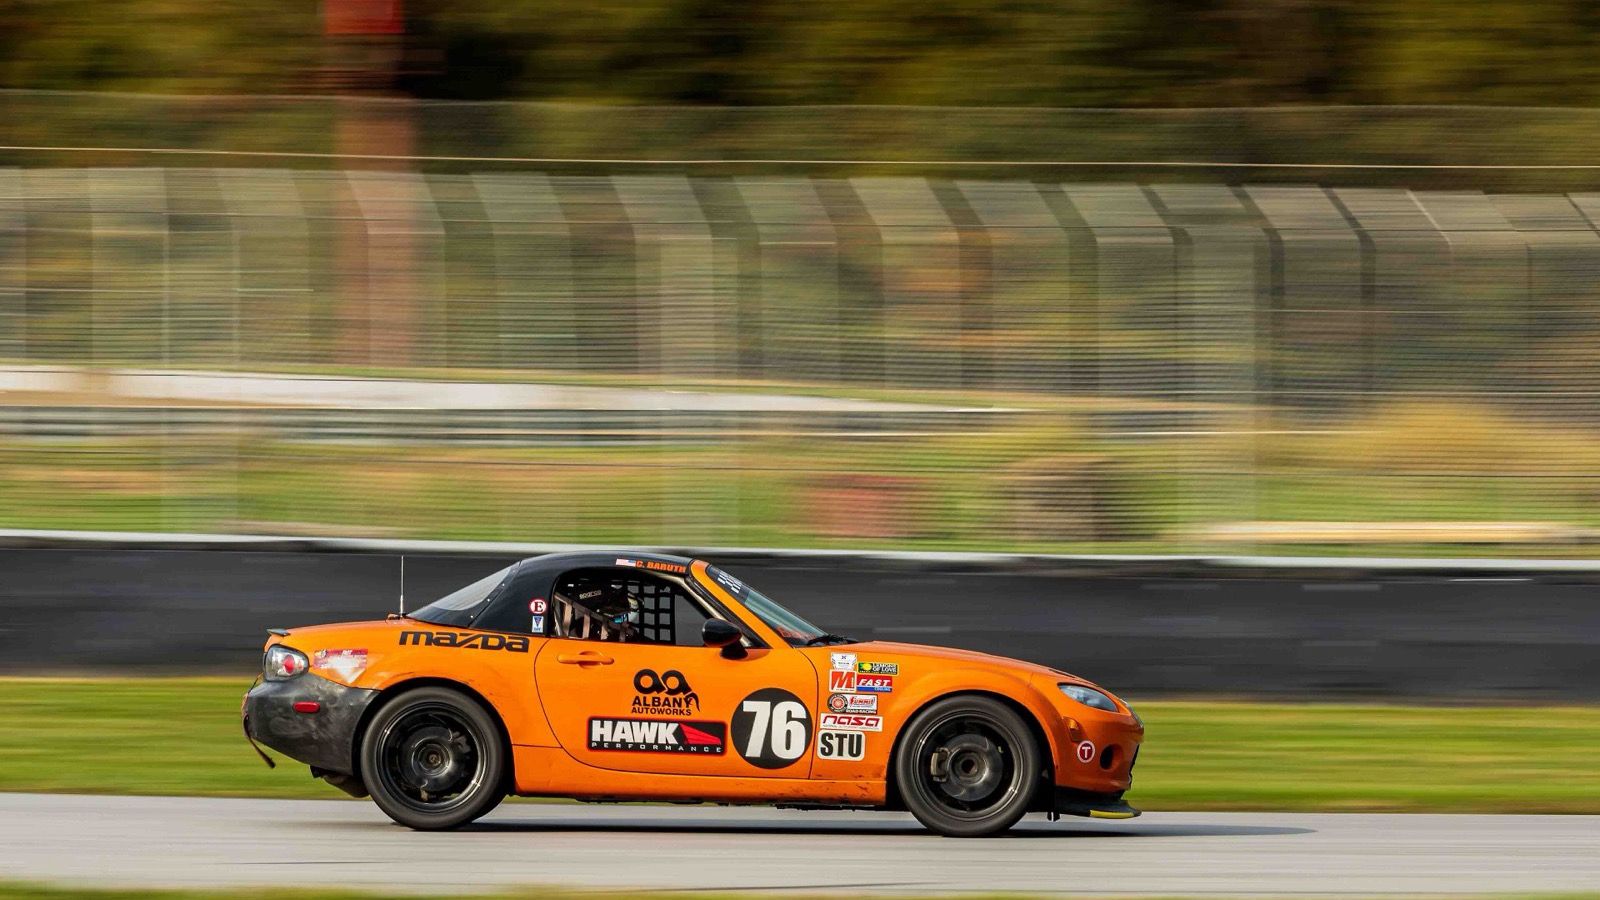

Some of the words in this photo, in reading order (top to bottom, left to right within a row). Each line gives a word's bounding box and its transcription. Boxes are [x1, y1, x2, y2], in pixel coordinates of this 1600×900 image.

[647, 561, 686, 574] BARUTH
[534, 601, 544, 613] E
[858, 678, 891, 687] FAST
[632, 696, 691, 709] ALBANY
[631, 707, 692, 717] AUTOWORKS
[591, 719, 680, 745] HAWK
[742, 700, 807, 760] 76
[591, 742, 722, 753] PERFORMANCE
[820, 732, 863, 758] STU
[1081, 746, 1092, 759] T
